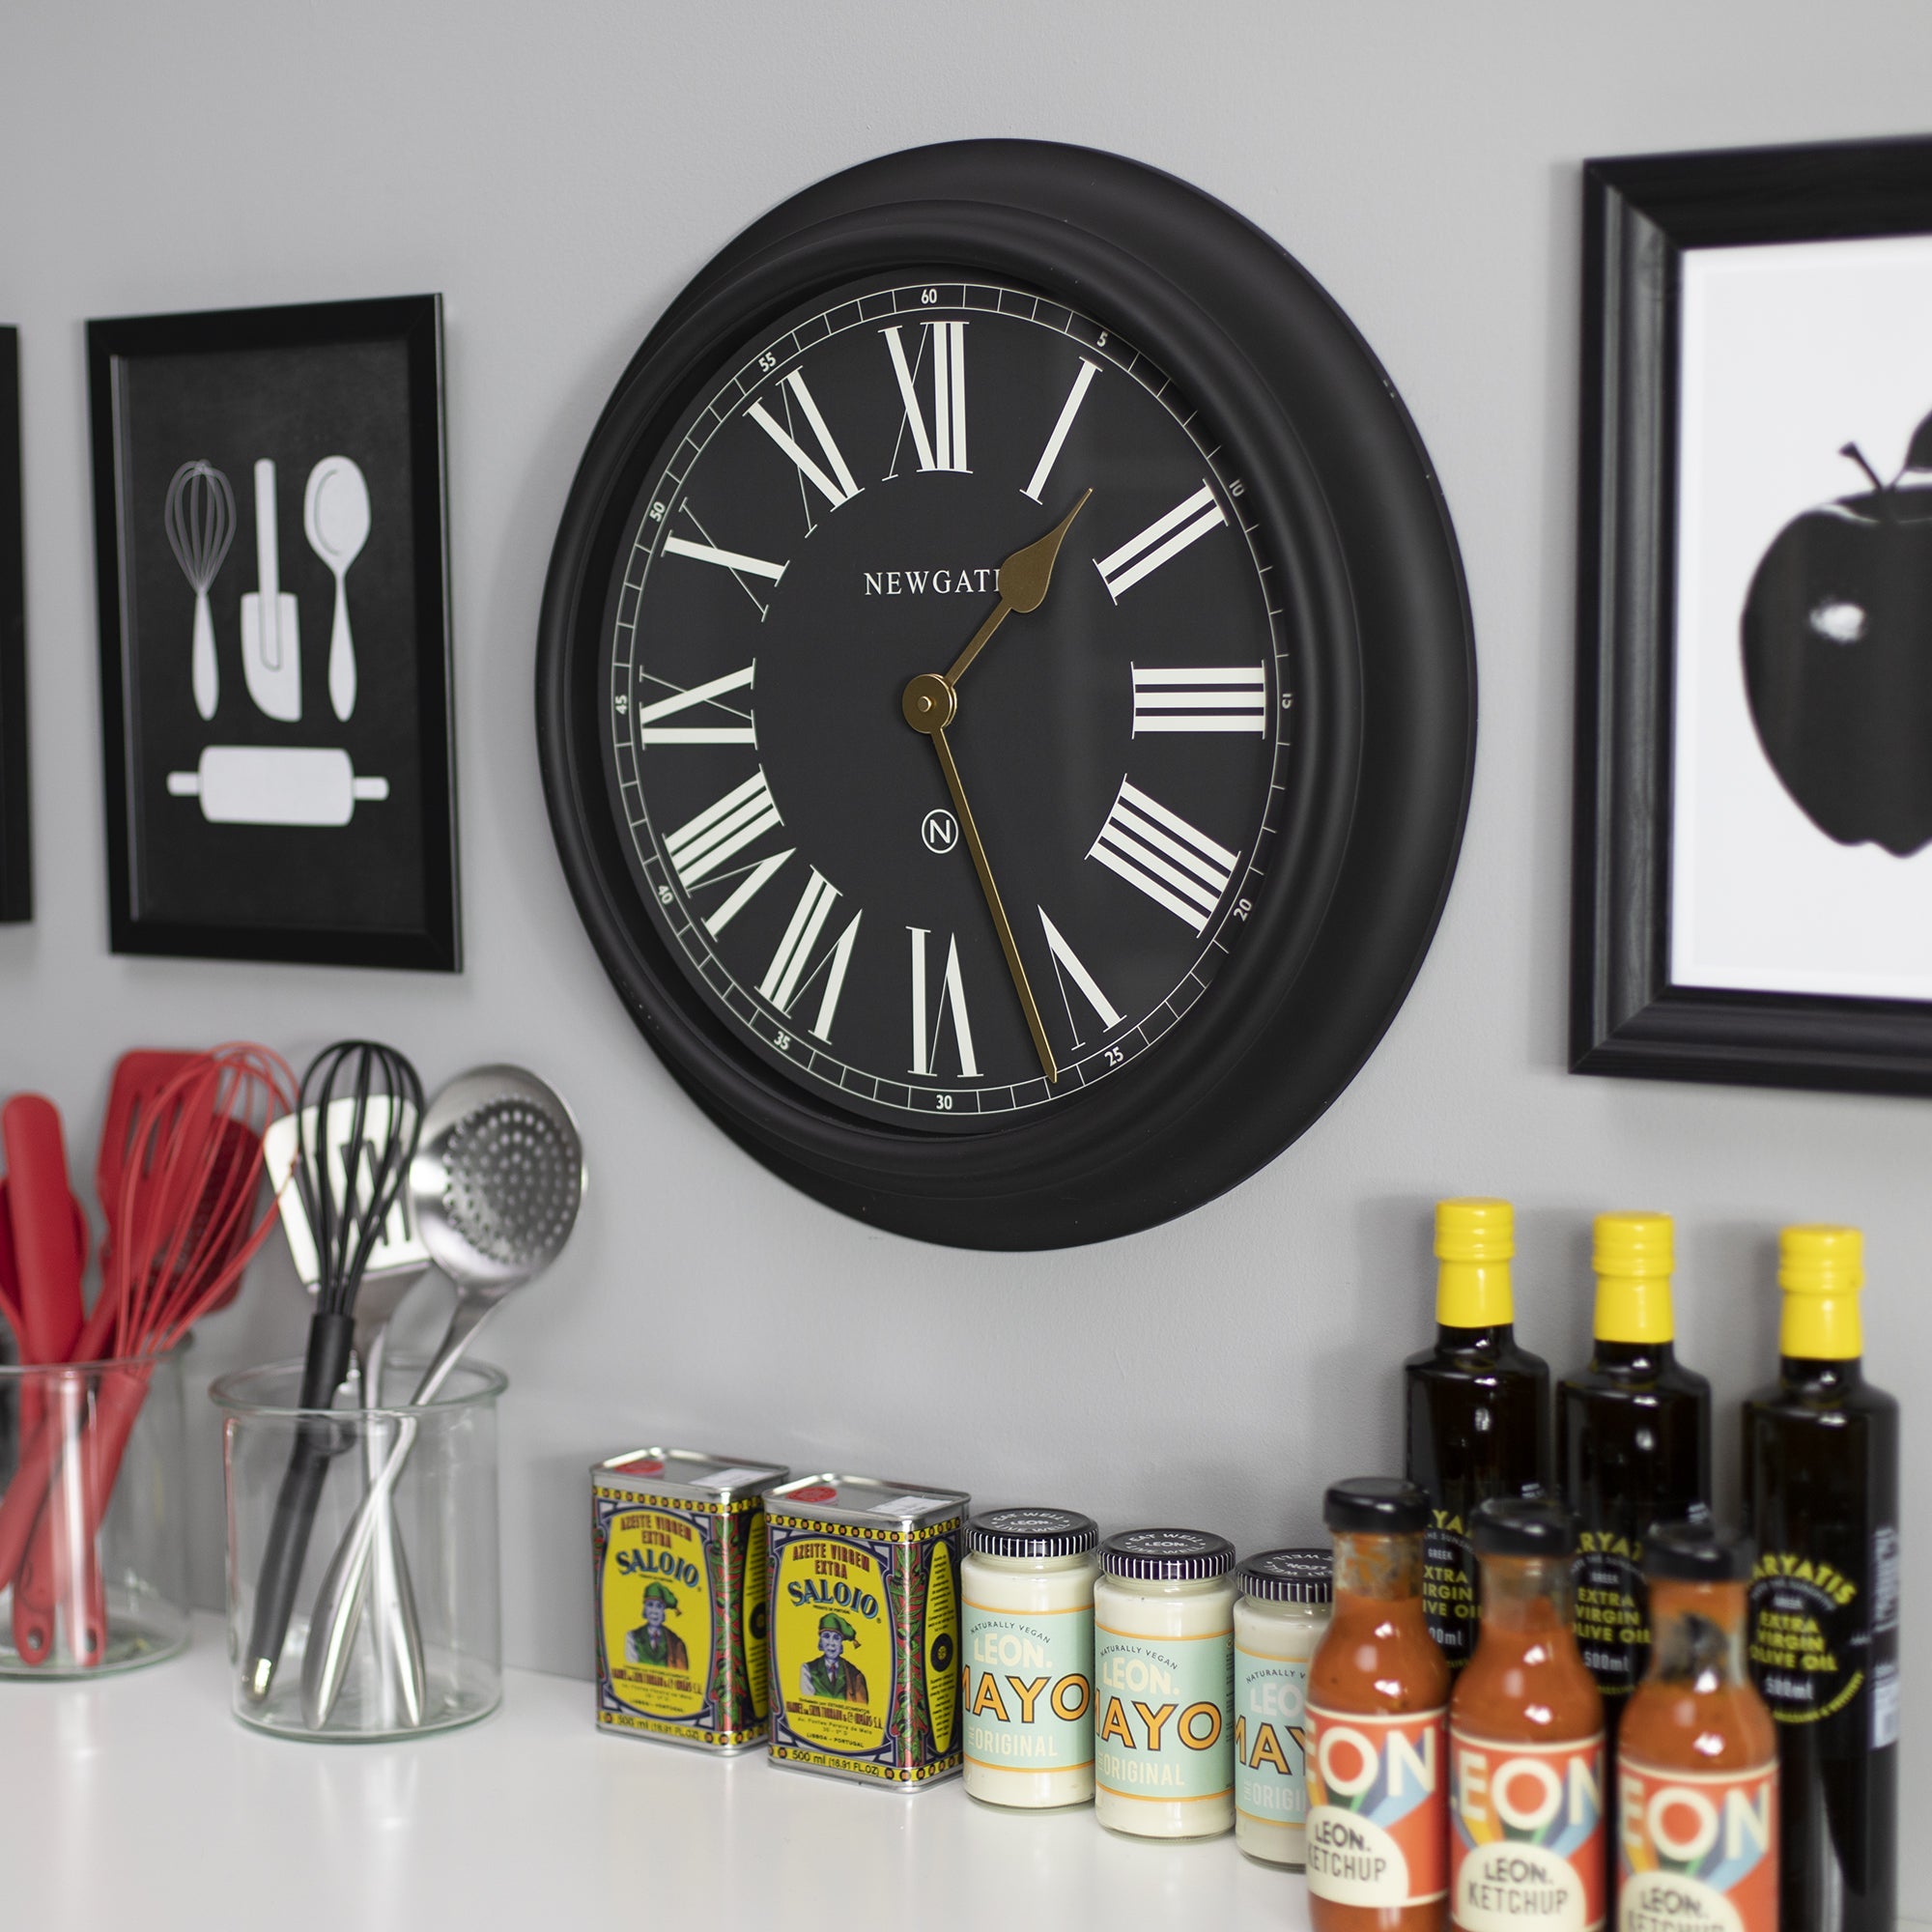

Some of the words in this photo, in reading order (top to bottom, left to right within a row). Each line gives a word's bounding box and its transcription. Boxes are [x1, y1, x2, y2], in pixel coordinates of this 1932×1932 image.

[921, 288, 938, 304] 60
[1096, 330, 1109, 348] 5
[757, 352, 777, 373] 55
[648, 500, 667, 523] 50
[614, 695, 628, 716] 45
[656, 884, 675, 905] 40
[1233, 897, 1254, 922] 20
[773, 1031, 792, 1051] 35
[1104, 1046, 1125, 1066] 25
[935, 1094, 953, 1112] 30
[615, 1548, 700, 1588] SALOIO
[792, 1543, 827, 1561] AZEITE
[830, 1544, 870, 1574] VIRGEM
[814, 1559, 848, 1580] EXTRA
[1424, 1565, 1468, 1584] XTRA
[1752, 1553, 1857, 1605] ARYATIS
[787, 1578, 879, 1620] SALOIO
[1423, 1582, 1473, 1602] IRGIN
[1577, 1587, 1635, 1608] EXTRA
[1576, 1604, 1640, 1626] VIRGIN
[970, 1621, 1015, 1634] NATURALLY
[1018, 1625, 1051, 1644] VEGAN
[974, 1633, 1053, 1669] LEON.
[1100, 1644, 1142, 1658] NATURALLY
[1145, 1650, 1179, 1670] VEGAN
[1583, 1651, 1630, 1672] 500ml
[1801, 1654, 1838, 1672] OIL
[1103, 1657, 1180, 1696] LEON.
[1245, 1669, 1295, 1685] NATURALLY
[1095, 1688, 1222, 1751] AYO
[975, 1727, 1059, 1757] ORIGINAL
[792, 1750, 810, 1762] 500
[812, 1754, 825, 1766] ml
[1103, 1753, 1185, 1787] ORIGINAL
[1452, 1748, 1604, 1831] EON
[1621, 1776, 1772, 1862] EON
[1468, 1881, 1569, 1916] KETCHUP
